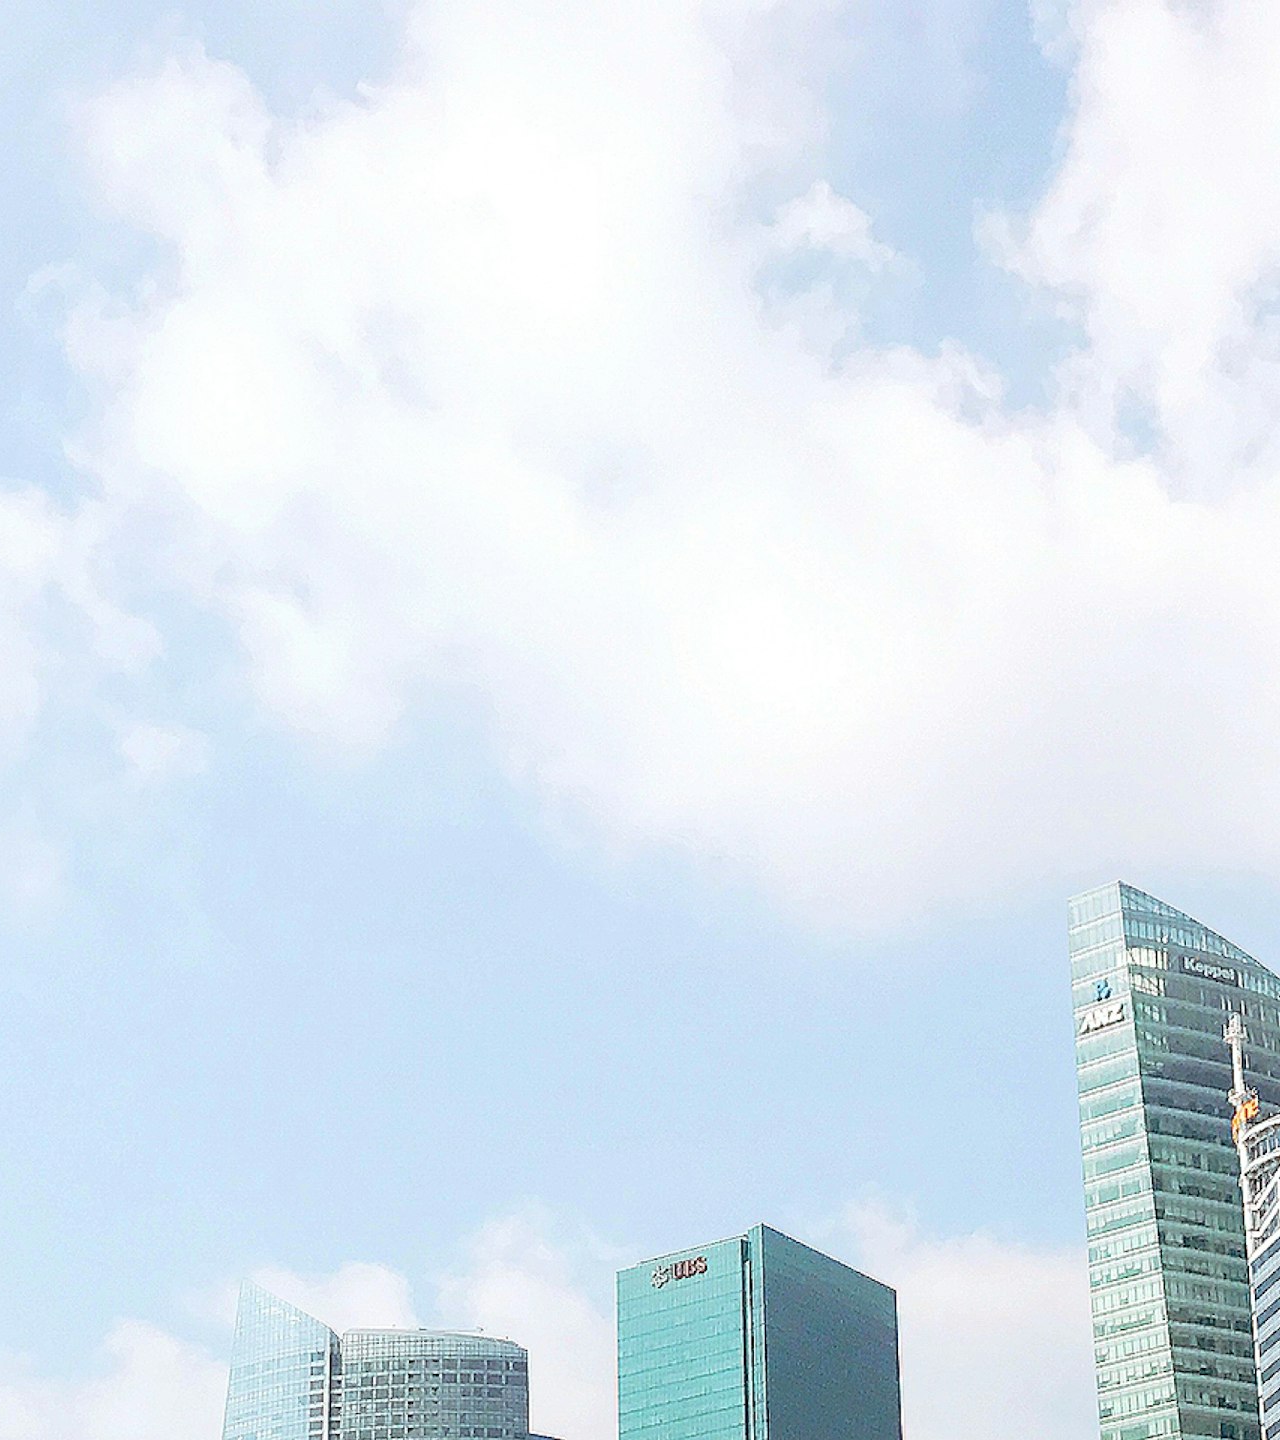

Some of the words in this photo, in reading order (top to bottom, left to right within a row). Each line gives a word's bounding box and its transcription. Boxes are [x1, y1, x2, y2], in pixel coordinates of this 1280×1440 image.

[1183, 956, 1235, 982] Keppel
[1080, 1003, 1125, 1035] ANZ
[671, 1257, 708, 1280] UBS
